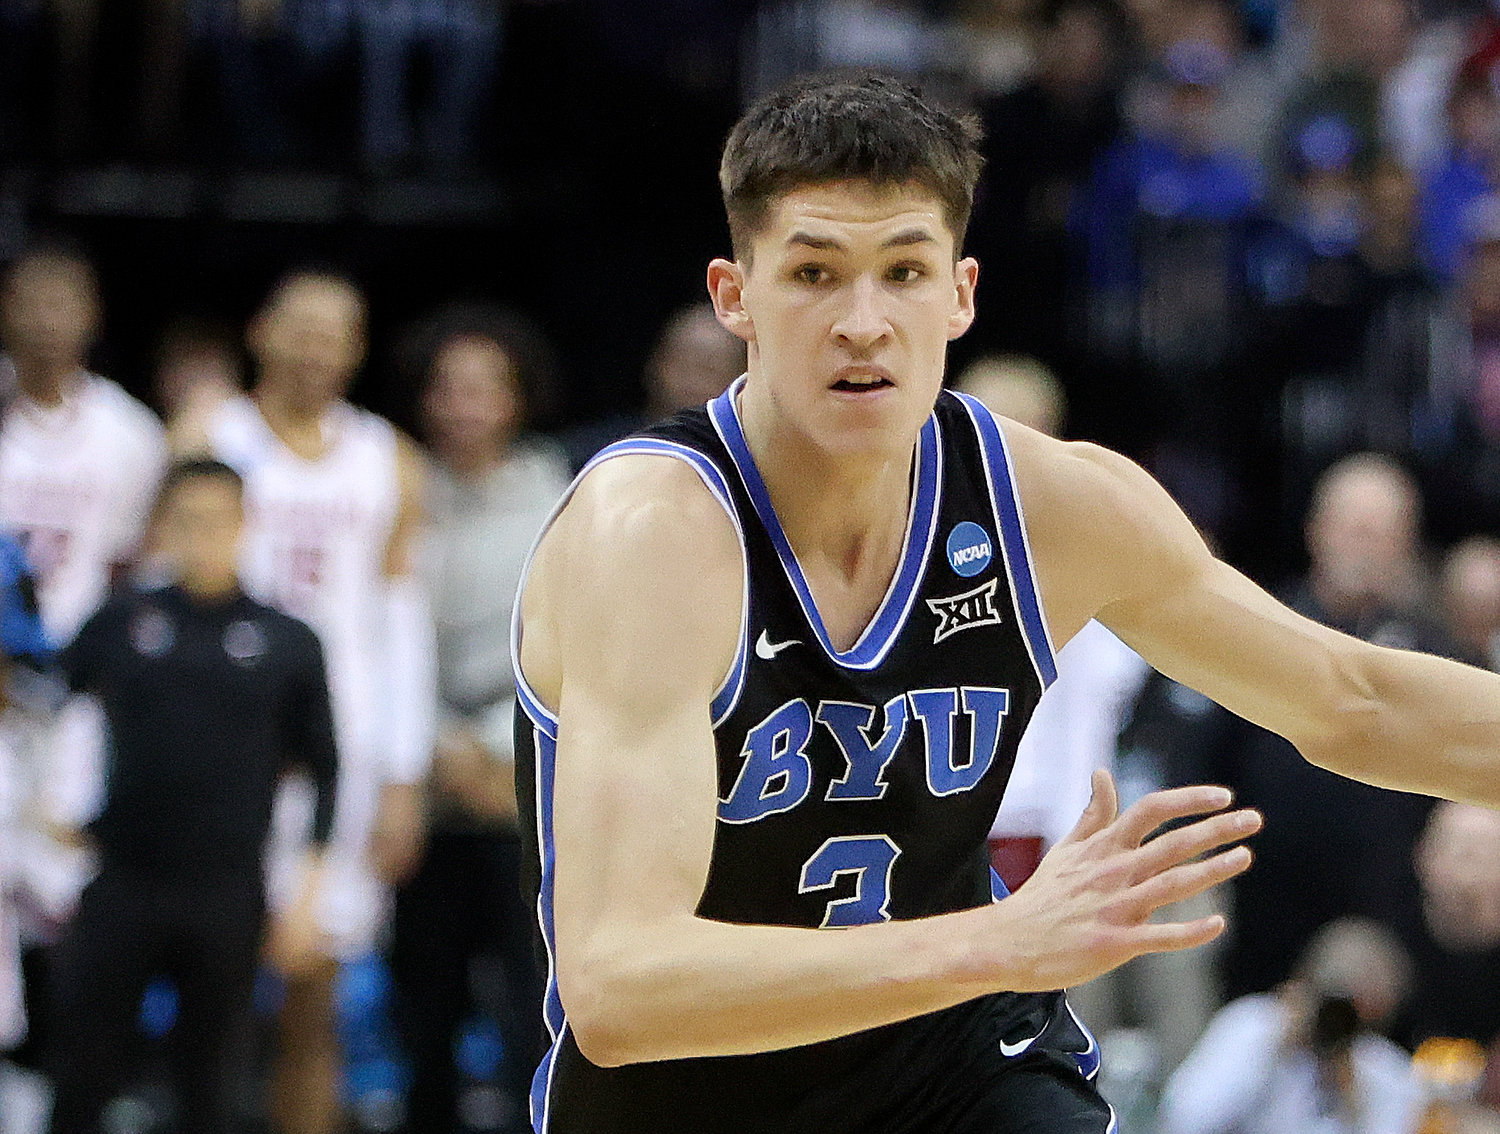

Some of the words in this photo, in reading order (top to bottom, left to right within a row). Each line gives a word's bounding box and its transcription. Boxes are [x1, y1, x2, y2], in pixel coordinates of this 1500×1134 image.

[952, 542, 990, 567] NCAA
[716, 686, 1009, 824] BYU
[798, 835, 902, 929] 3
